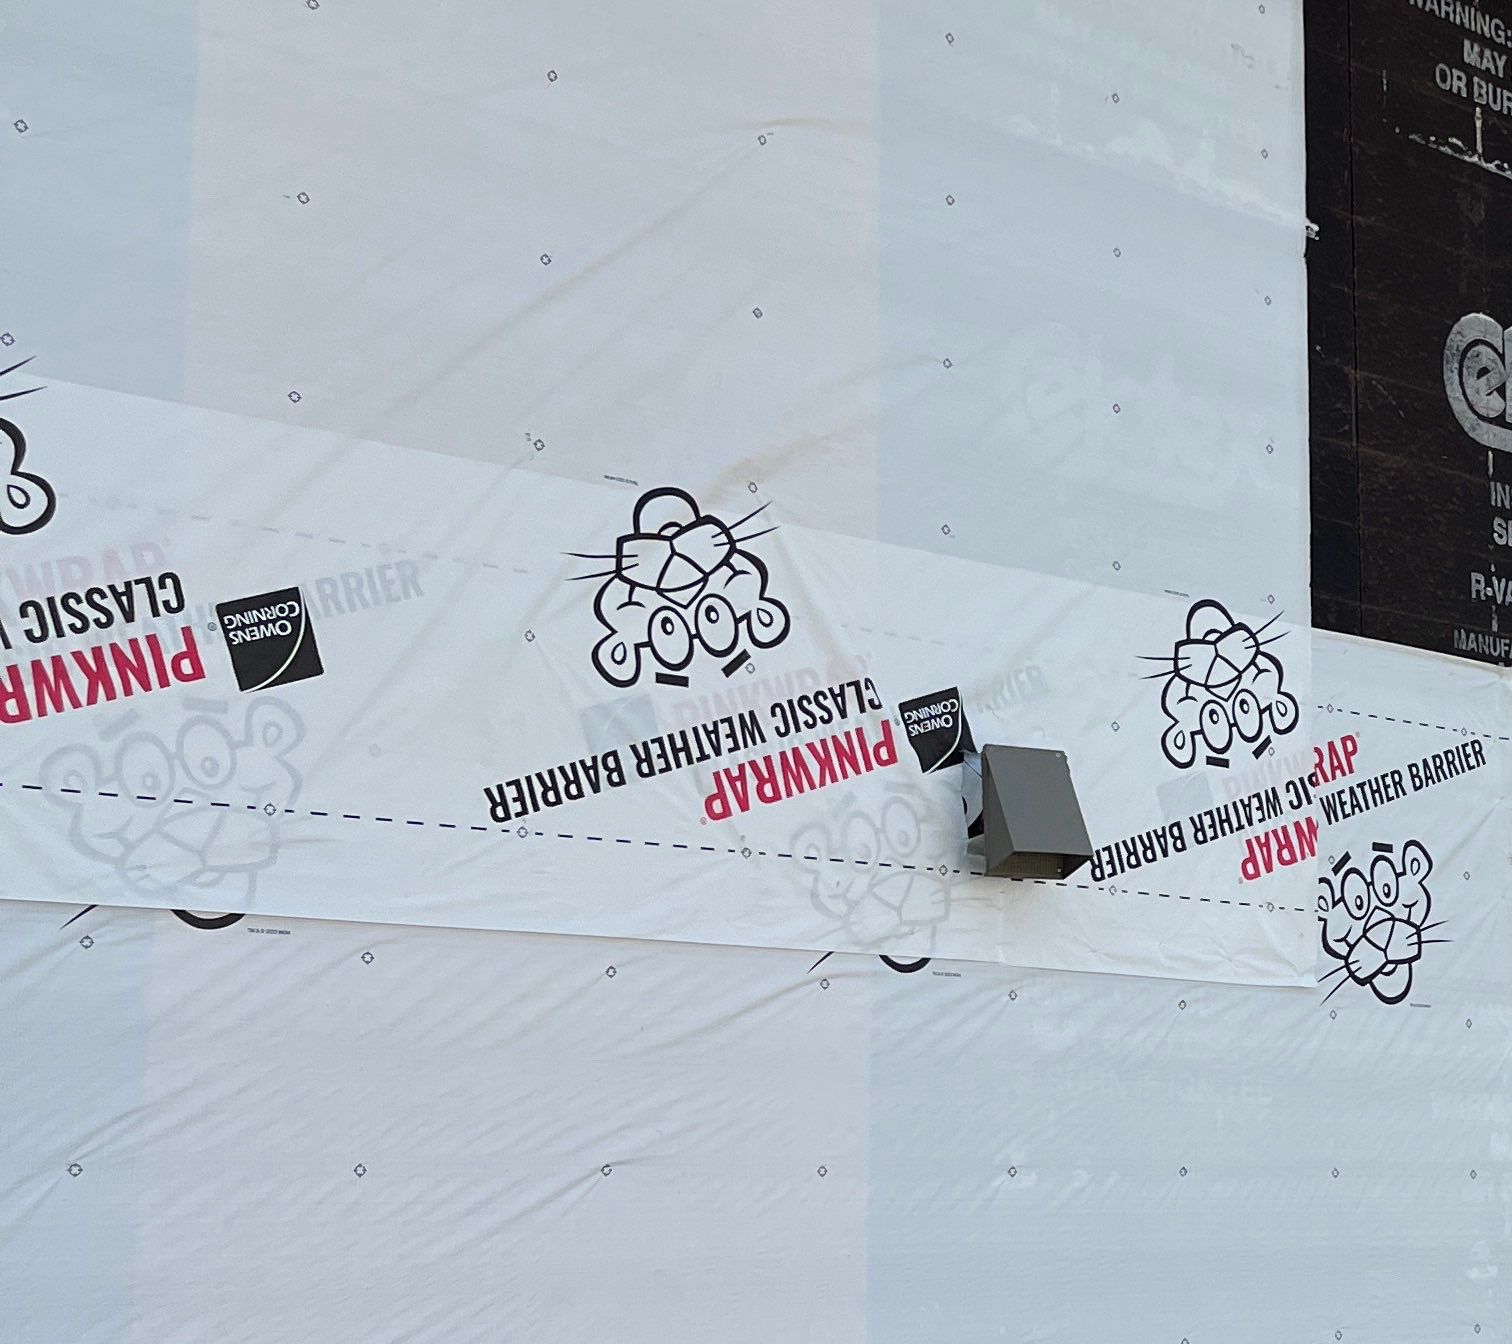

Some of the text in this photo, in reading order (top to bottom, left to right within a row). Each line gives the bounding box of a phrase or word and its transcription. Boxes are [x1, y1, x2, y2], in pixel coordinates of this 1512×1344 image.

[1434, 62, 1468, 99] OR
[1462, 38, 1508, 79] MAY
[18, 570, 187, 645] CLASSIC
[222, 599, 301, 632] CORNING
[229, 620, 294, 646] OWENS
[773, 675, 885, 735] CLASSIC
[904, 696, 960, 724] CORNING
[907, 714, 954, 738] OWENS
[629, 707, 768, 779] WEATHER
[703, 719, 900, 822] PINKWRAP
[483, 751, 627, 824] BARRIER
[1318, 769, 1407, 826] WEATHER
[1406, 737, 1487, 793] BARRIER
[1089, 819, 1187, 883] BARRIER
[1188, 786, 1285, 857] WEATHER
